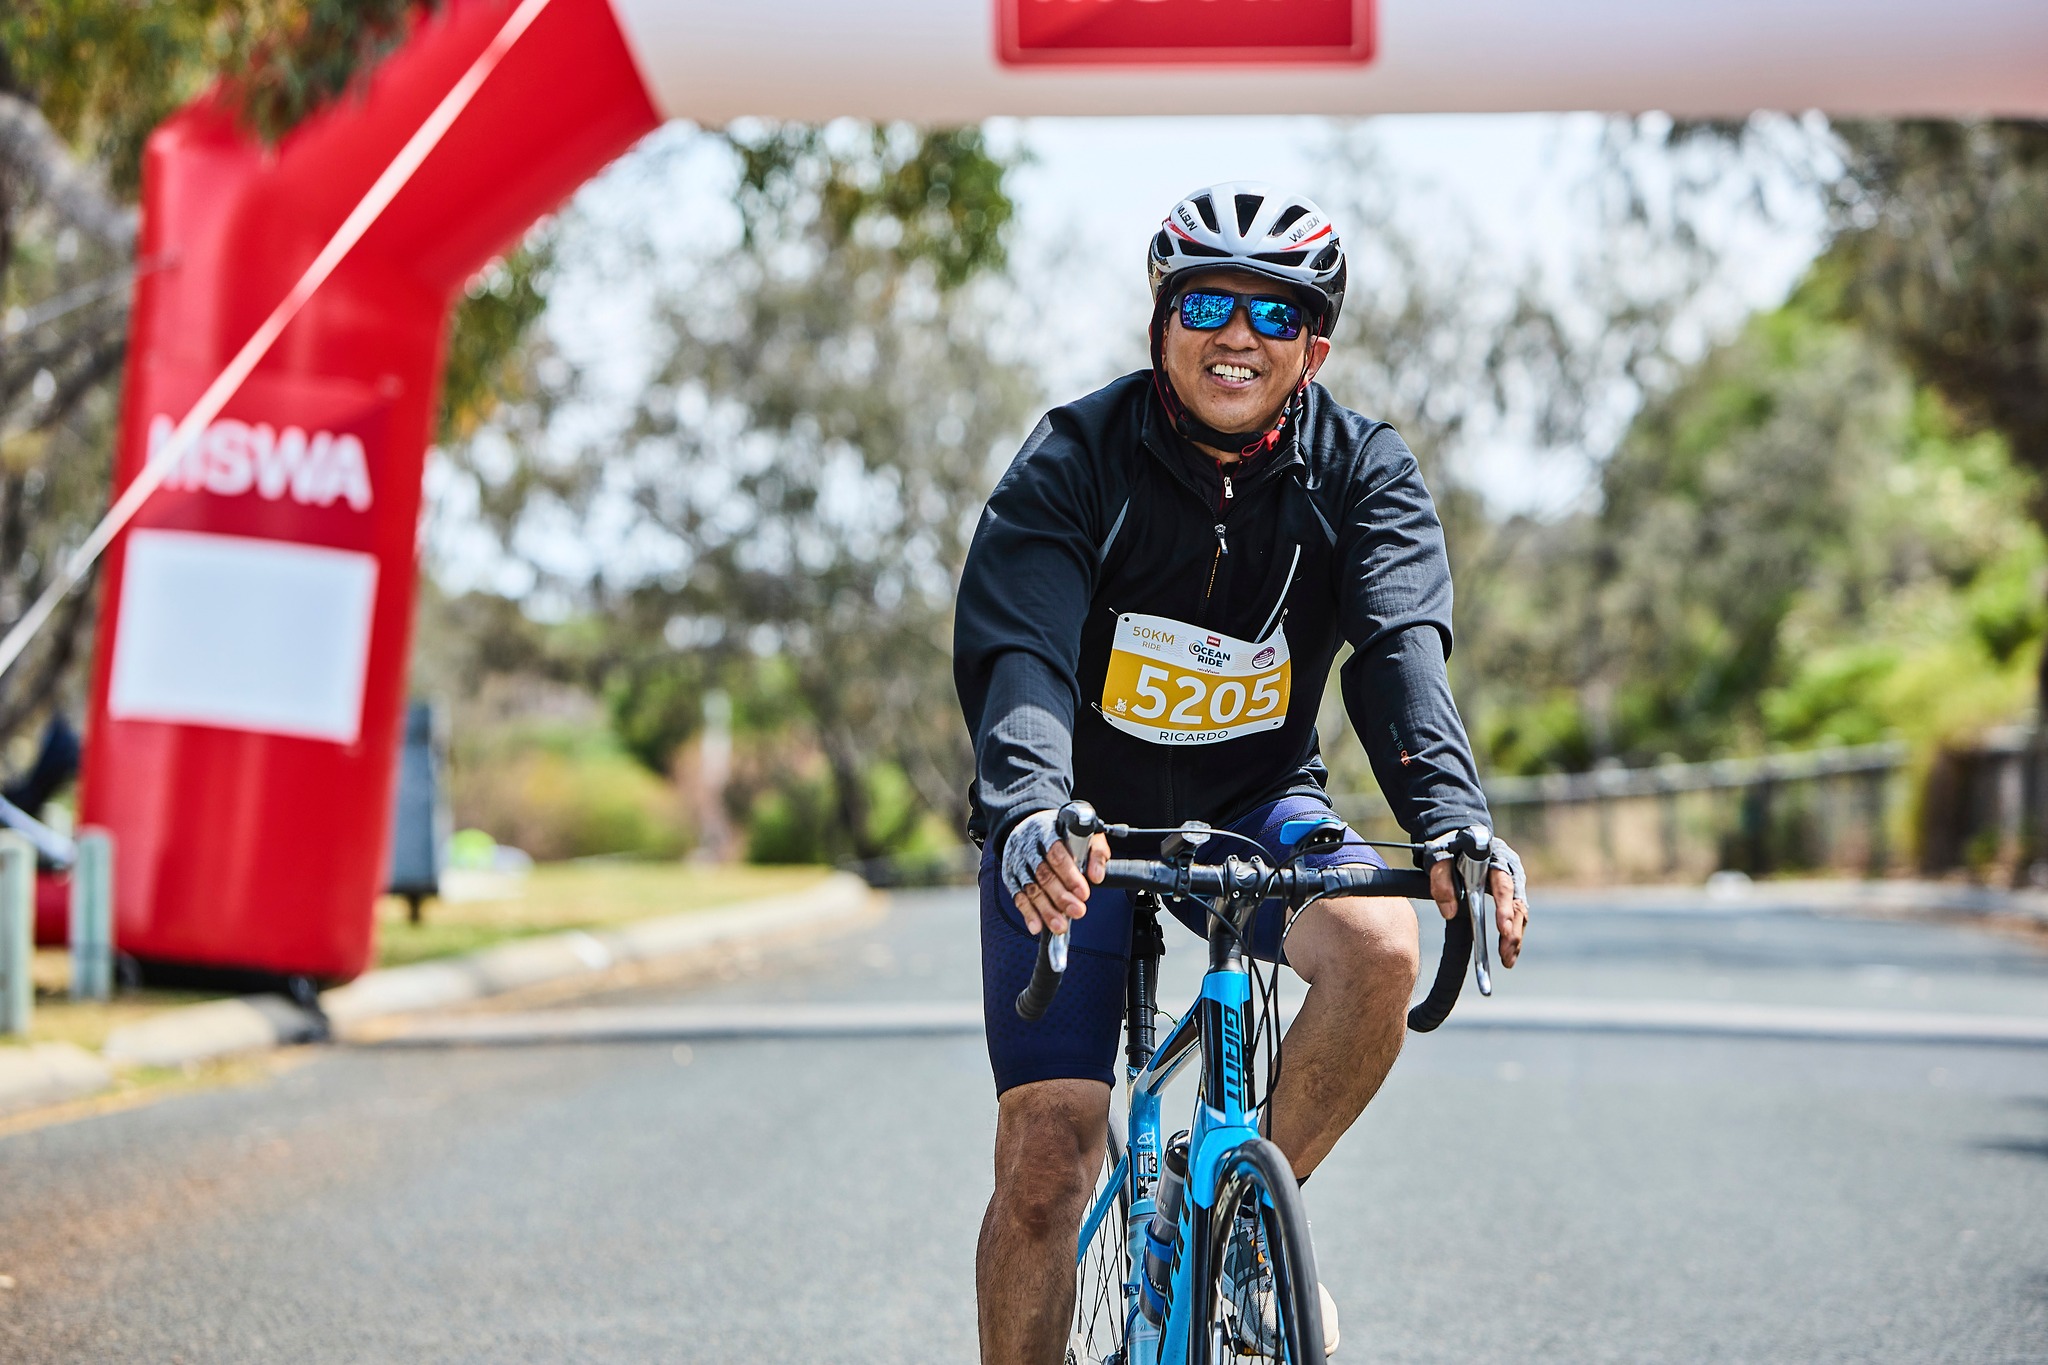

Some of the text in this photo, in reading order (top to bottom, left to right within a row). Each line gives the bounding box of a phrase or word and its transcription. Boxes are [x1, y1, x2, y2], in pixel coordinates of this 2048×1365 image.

[1132, 626, 1175, 646] 50KM
[1142, 640, 1161, 651] RIDE
[1192, 644, 1231, 661] OCEAN
[1197, 654, 1224, 668] RIDE
[1131, 664, 1281, 724] 5205
[1159, 730, 1229, 742] RICARDO
[1223, 1003, 1243, 1114] GIANT
